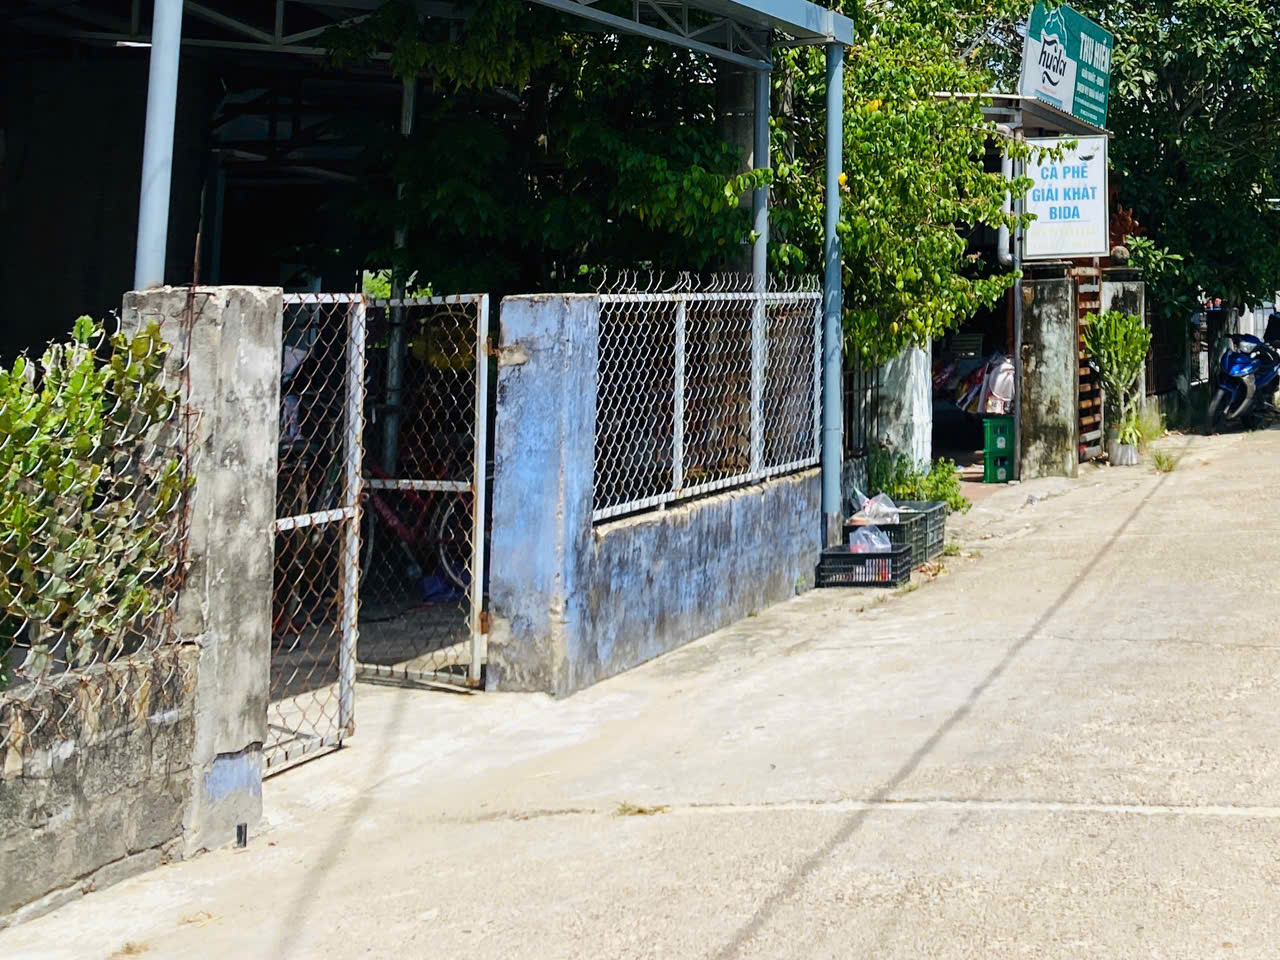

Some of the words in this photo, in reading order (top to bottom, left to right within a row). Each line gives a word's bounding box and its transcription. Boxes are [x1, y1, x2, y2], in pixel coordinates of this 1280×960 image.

[1063, 161, 1088, 179] PHÊ
[1032, 184, 1059, 202] GIẢI
[1063, 183, 1097, 201] KHÁT
[1049, 206, 1081, 220] BIDA
